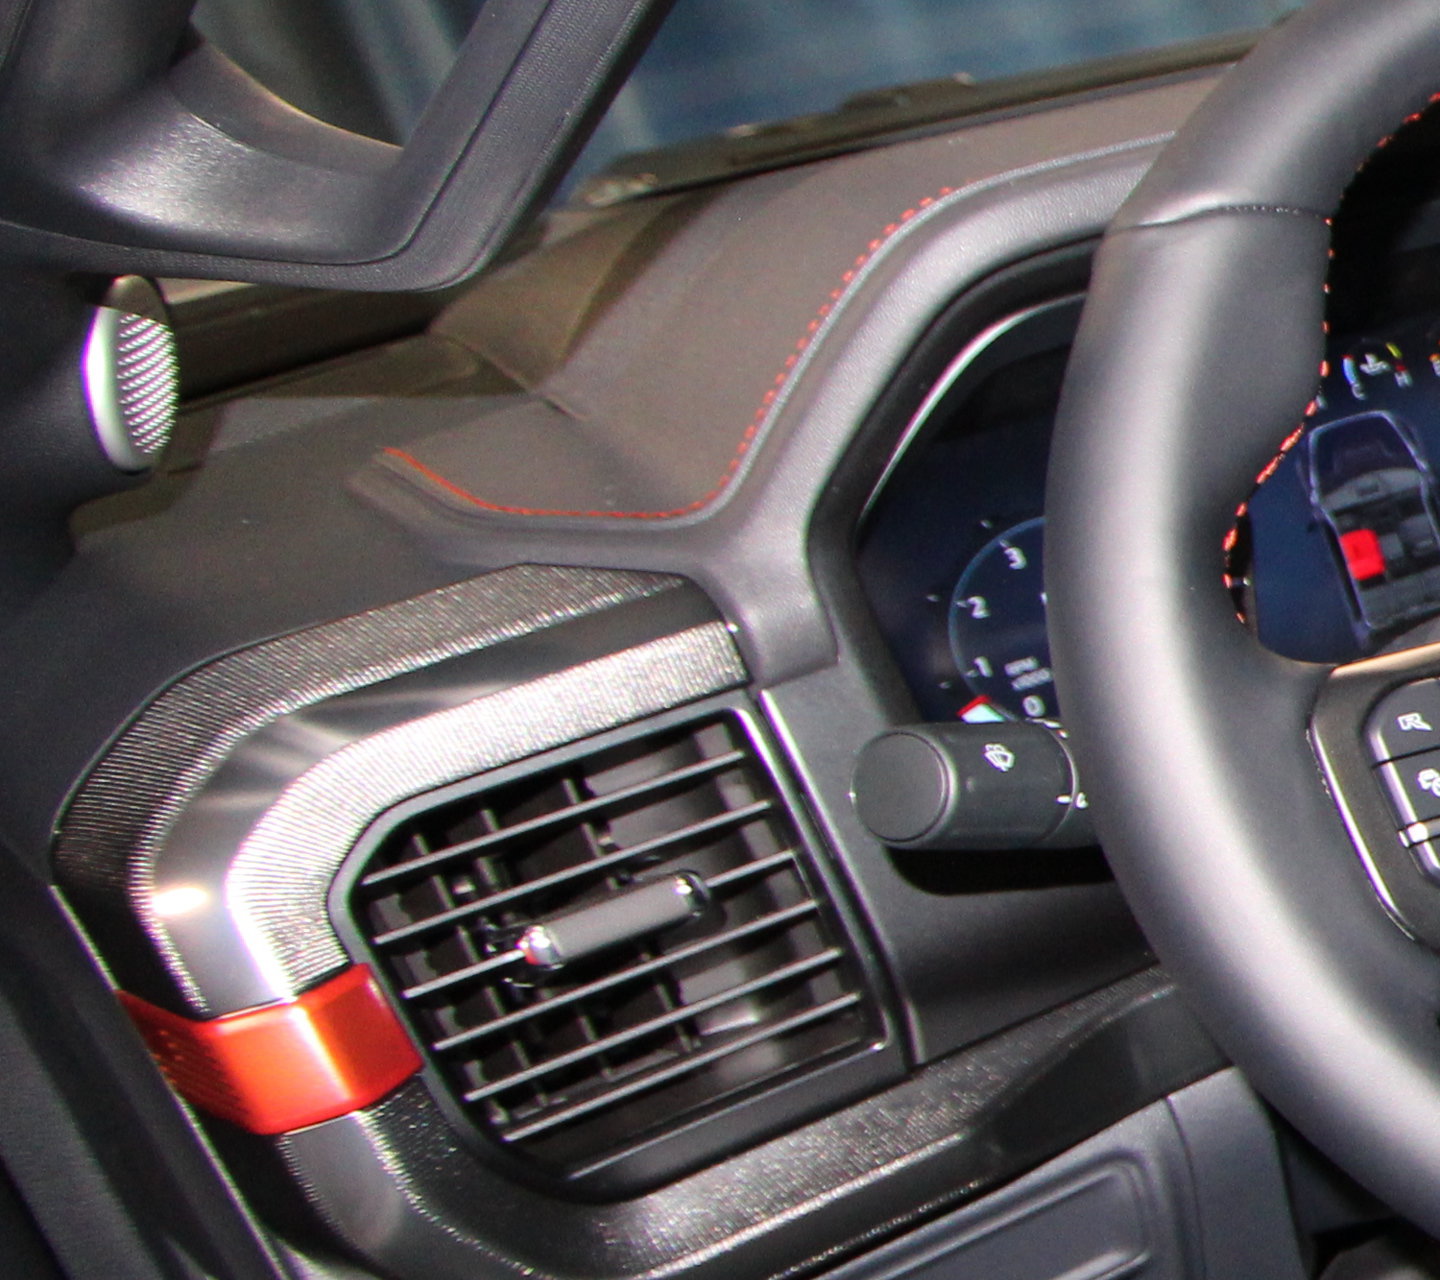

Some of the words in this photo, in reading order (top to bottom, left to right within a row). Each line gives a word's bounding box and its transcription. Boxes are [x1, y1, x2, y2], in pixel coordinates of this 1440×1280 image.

[1004, 546, 1027, 570] 3
[967, 596, 990, 619] 2
[974, 656, 993, 678] 1
[1022, 695, 1046, 718] 0
